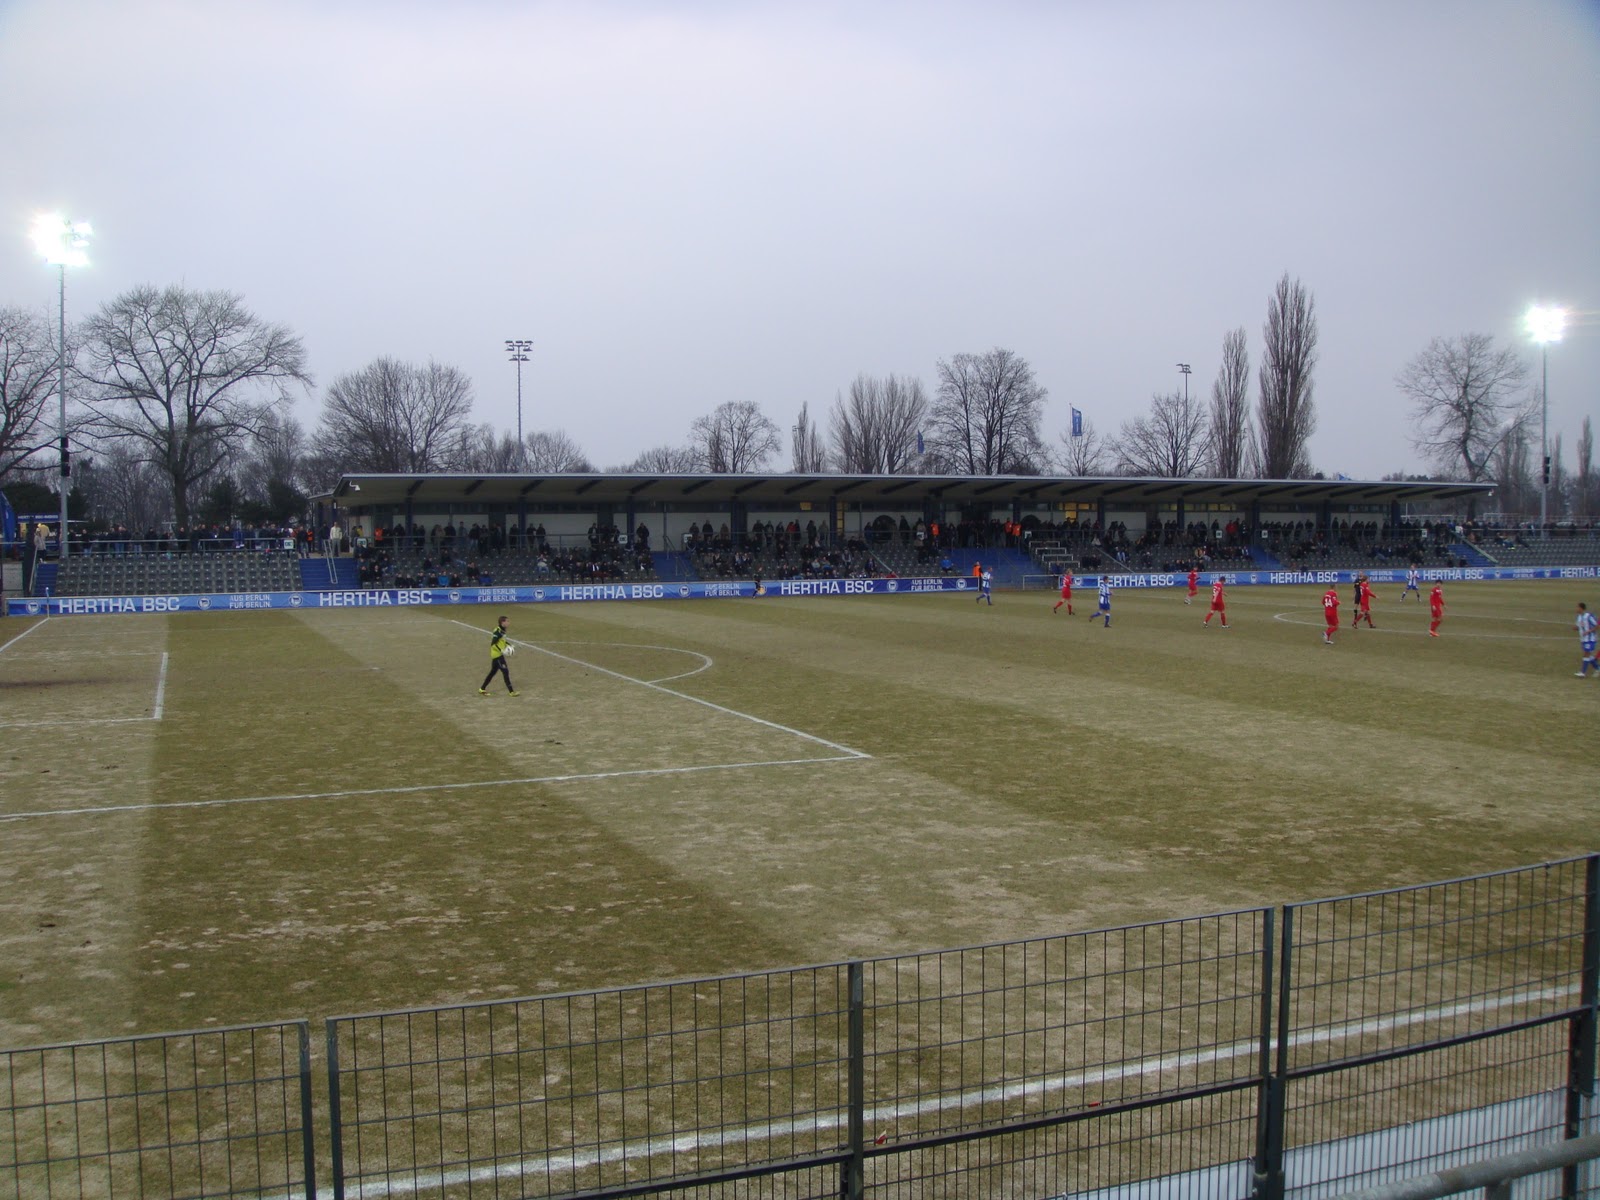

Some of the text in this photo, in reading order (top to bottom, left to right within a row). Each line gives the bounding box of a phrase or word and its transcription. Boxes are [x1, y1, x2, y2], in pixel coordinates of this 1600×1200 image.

[1270, 571, 1338, 584] HERTHA BSC
[1423, 569, 1484, 580] HERTHA BSC
[1560, 567, 1595, 578] HERTHA
[1150, 574, 1174, 586] BSC
[561, 585, 664, 600] HERTHA BSC
[781, 580, 874, 595] HERTHA BSC
[59, 597, 180, 613] HERTHA BSC
[319, 590, 432, 607] HERTHA BSC
